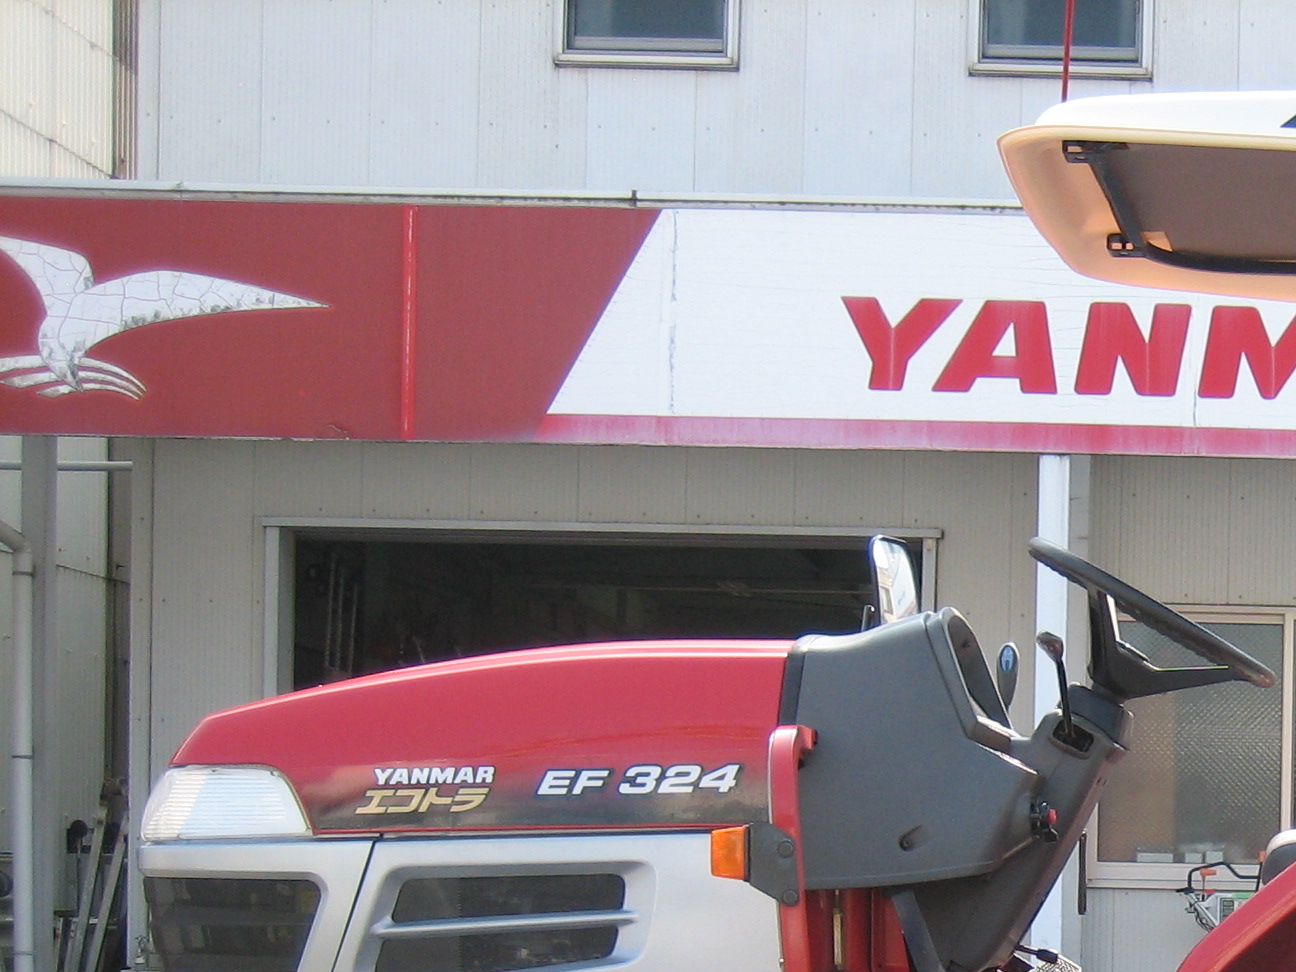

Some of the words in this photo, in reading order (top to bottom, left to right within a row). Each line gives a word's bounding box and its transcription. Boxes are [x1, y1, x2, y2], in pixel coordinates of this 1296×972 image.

[373, 766, 495, 786] YANMAR
[536, 769, 610, 796] EF
[617, 764, 741, 795] 324
[354, 787, 492, 815] エコトラ
